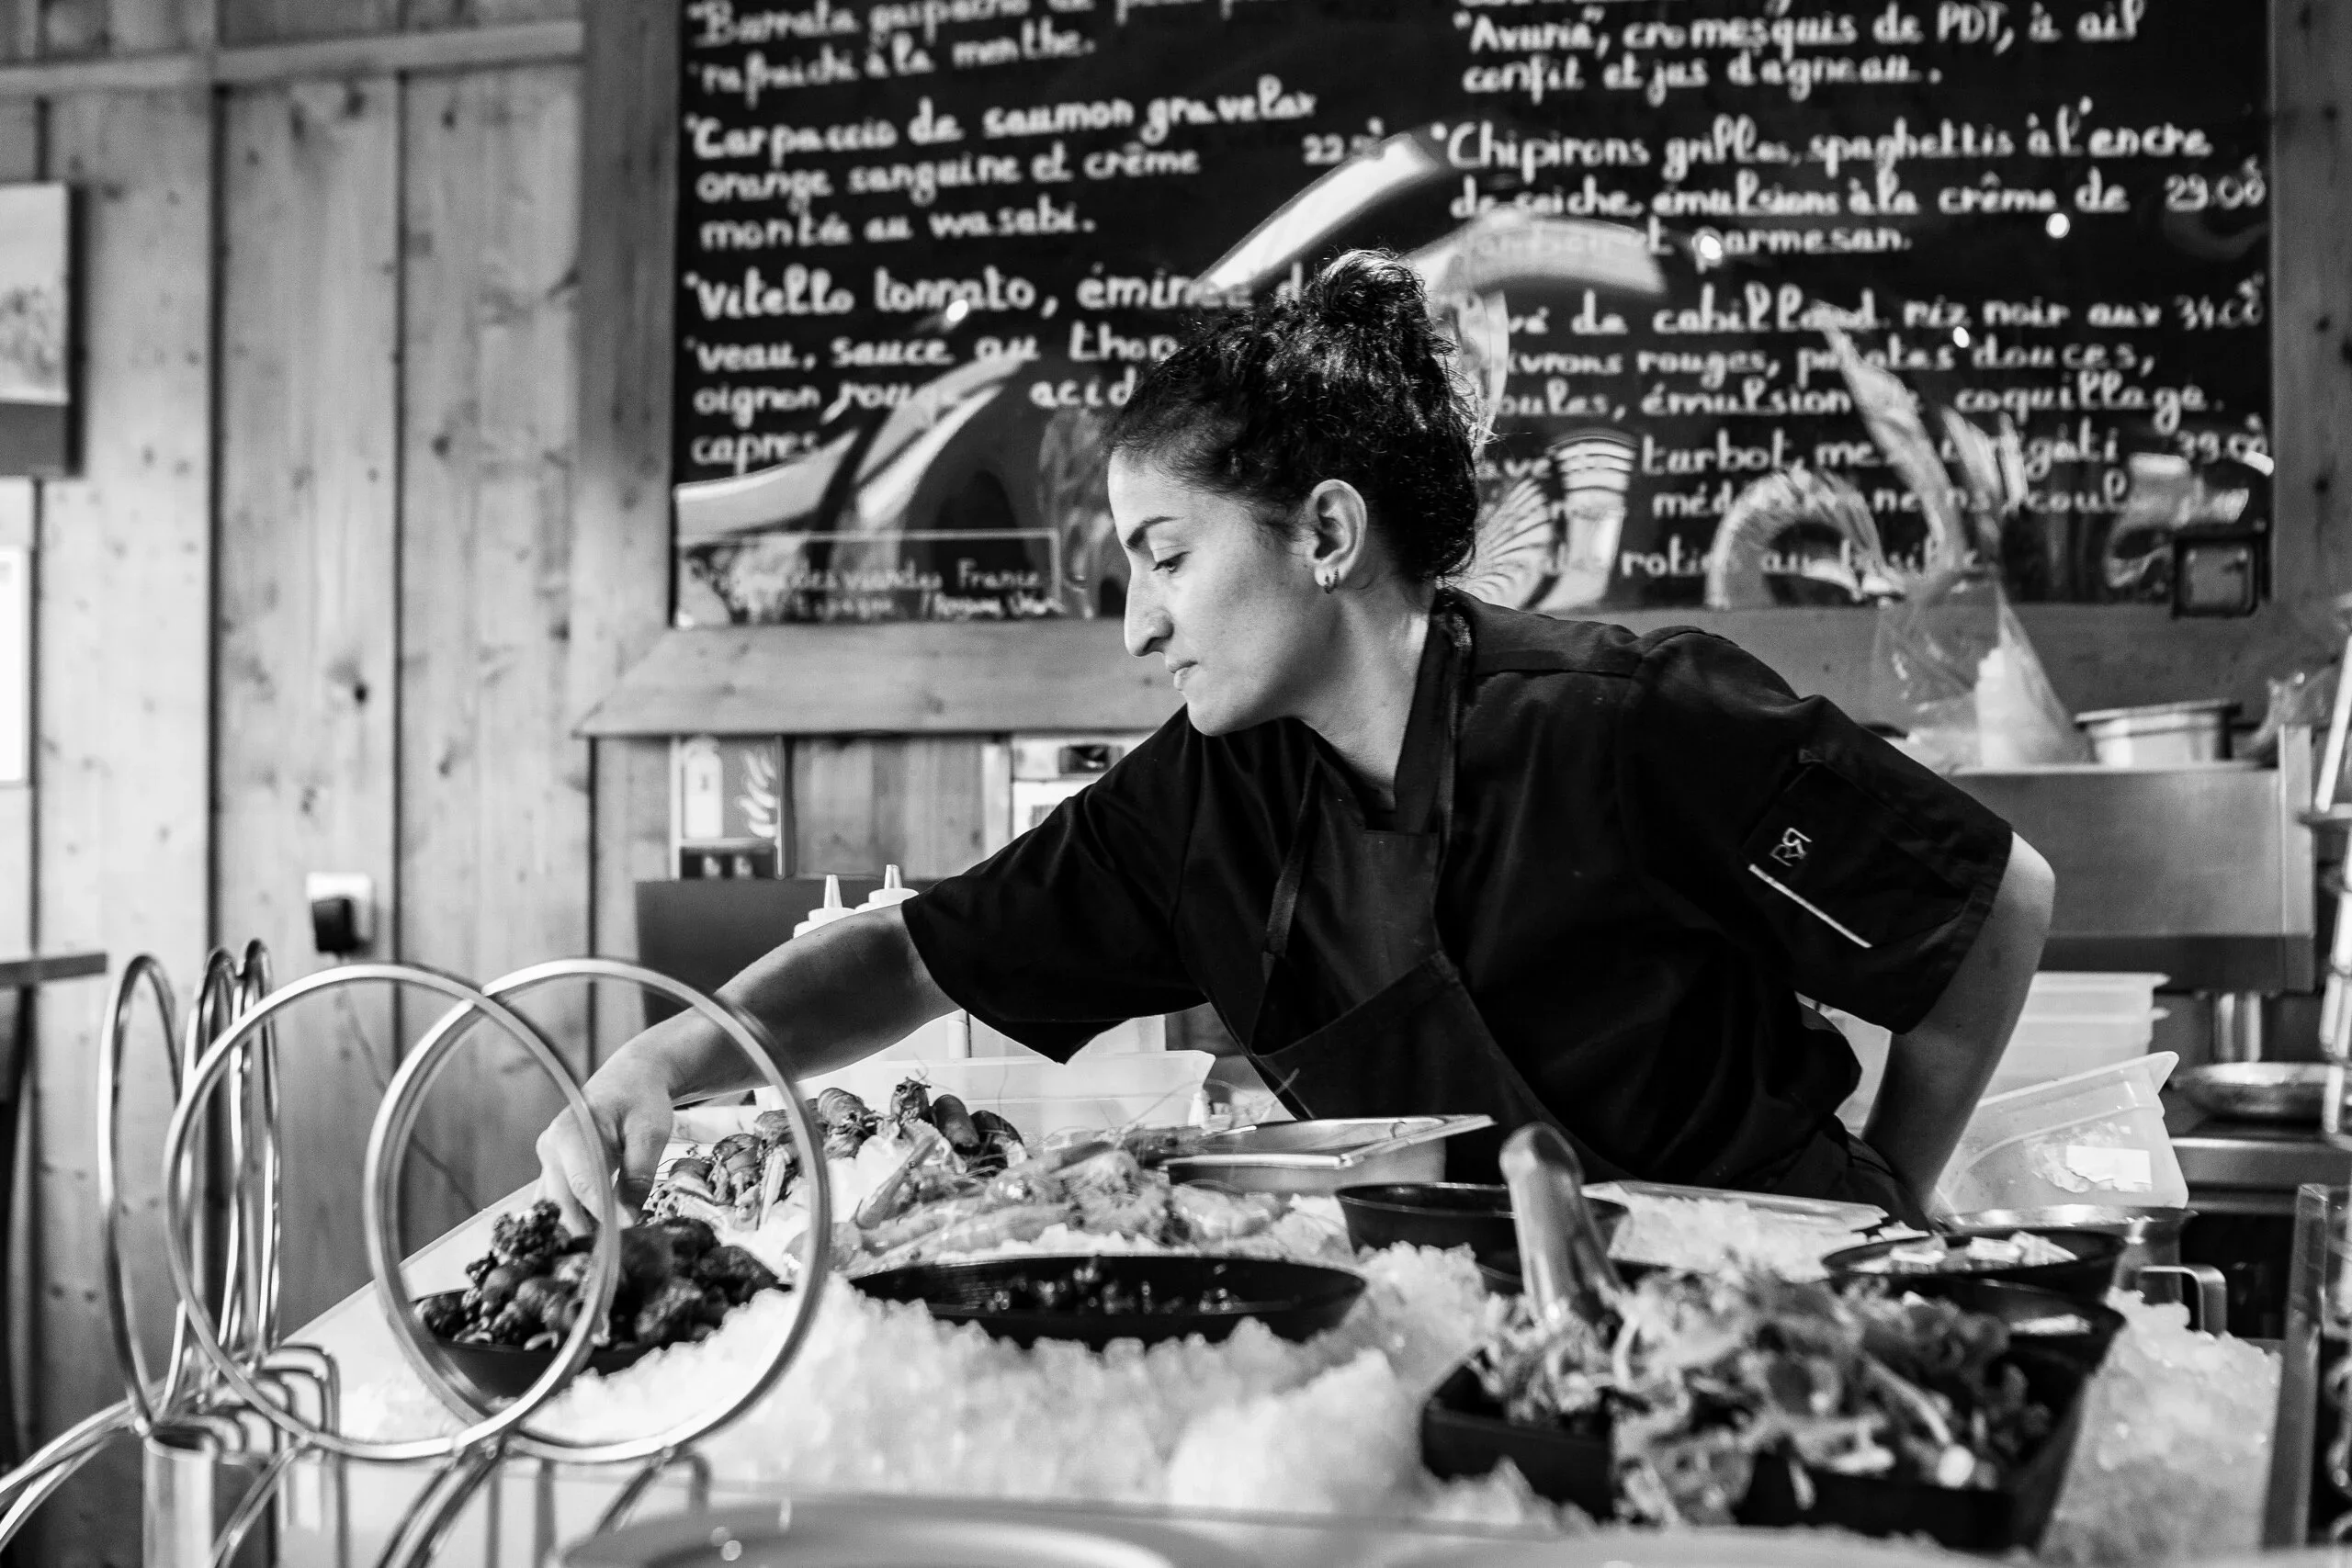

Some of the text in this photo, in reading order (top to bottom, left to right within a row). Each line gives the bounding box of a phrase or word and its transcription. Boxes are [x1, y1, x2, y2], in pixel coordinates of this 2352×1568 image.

[1872, 1, 1926, 45] de
[1938, 2, 2015, 56] PDT,
[1461, 52, 1587, 107] confit
[1645, 55, 1710, 108] jus
[908, 96, 965, 146] de
[982, 98, 1136, 139] saumon
[695, 168, 833, 216] orange
[847, 152, 1022, 208] sanguine
[1030, 140, 1075, 185] et
[1876, 167, 1920, 217] la
[2074, 164, 2132, 214] de
[864, 214, 914, 243] au
[696, 263, 856, 321] Vitello
[1570, 288, 1630, 335] de
[1982, 295, 2072, 329] noir
[830, 336, 957, 367] sauce
[692, 380, 821, 430] oignon
